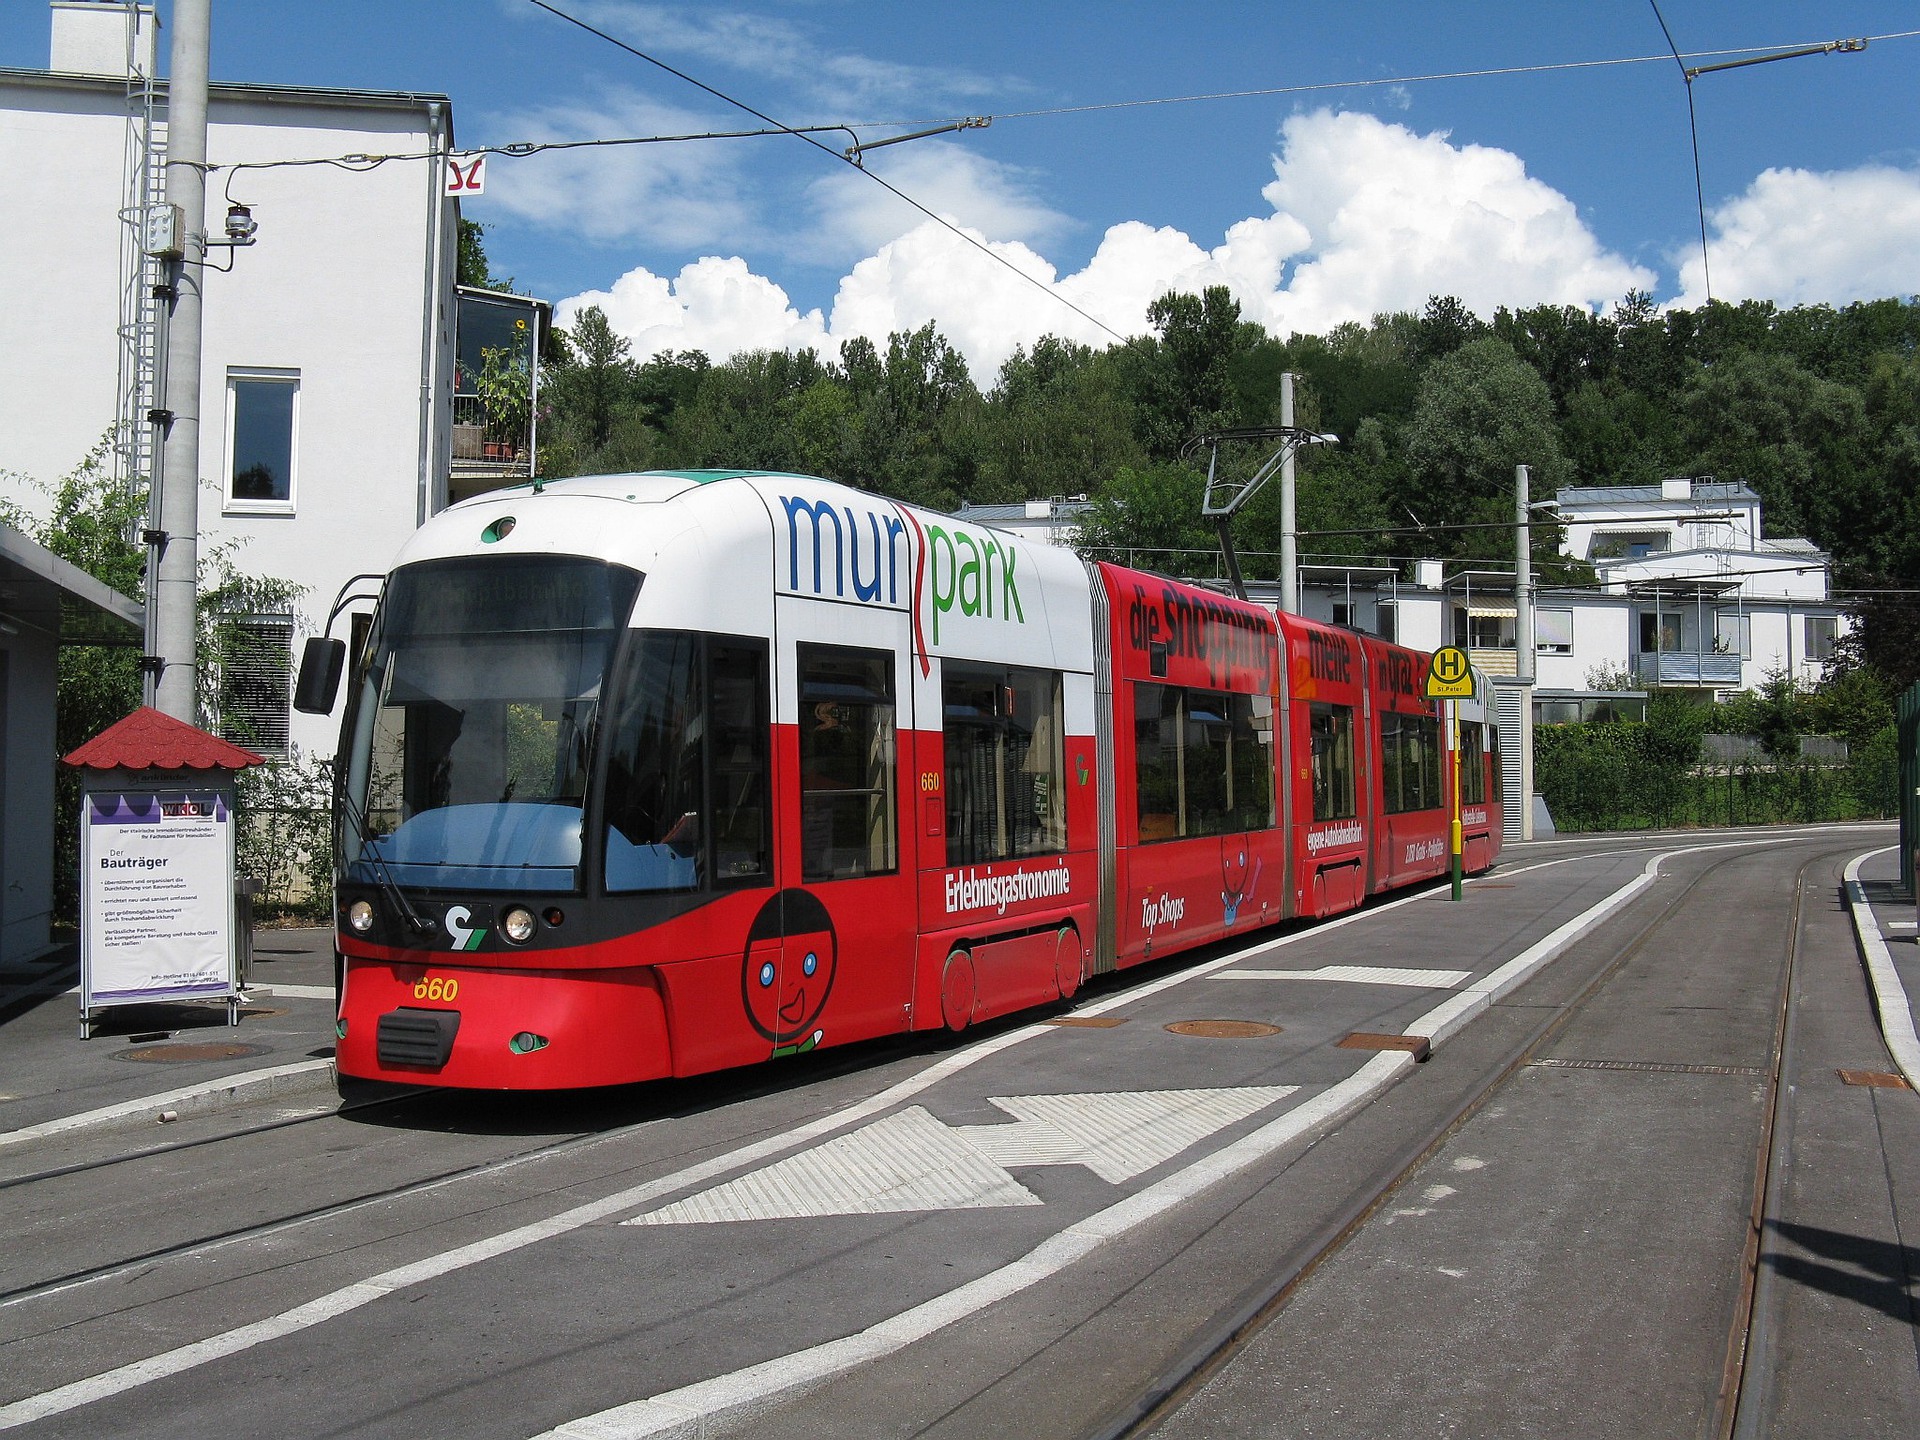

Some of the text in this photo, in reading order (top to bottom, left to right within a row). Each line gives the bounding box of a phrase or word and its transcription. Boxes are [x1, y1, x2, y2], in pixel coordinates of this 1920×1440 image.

[779, 495, 1025, 646] mur park
[1440, 653, 1459, 676] H
[920, 772, 940, 792] 660
[100, 856, 169, 870] Bauträger
[109, 849, 124, 857] Der
[945, 857, 1070, 915] Erlebnisgastronomie
[1141, 892, 1185, 935] Top Shops
[413, 976, 459, 1002] 660
